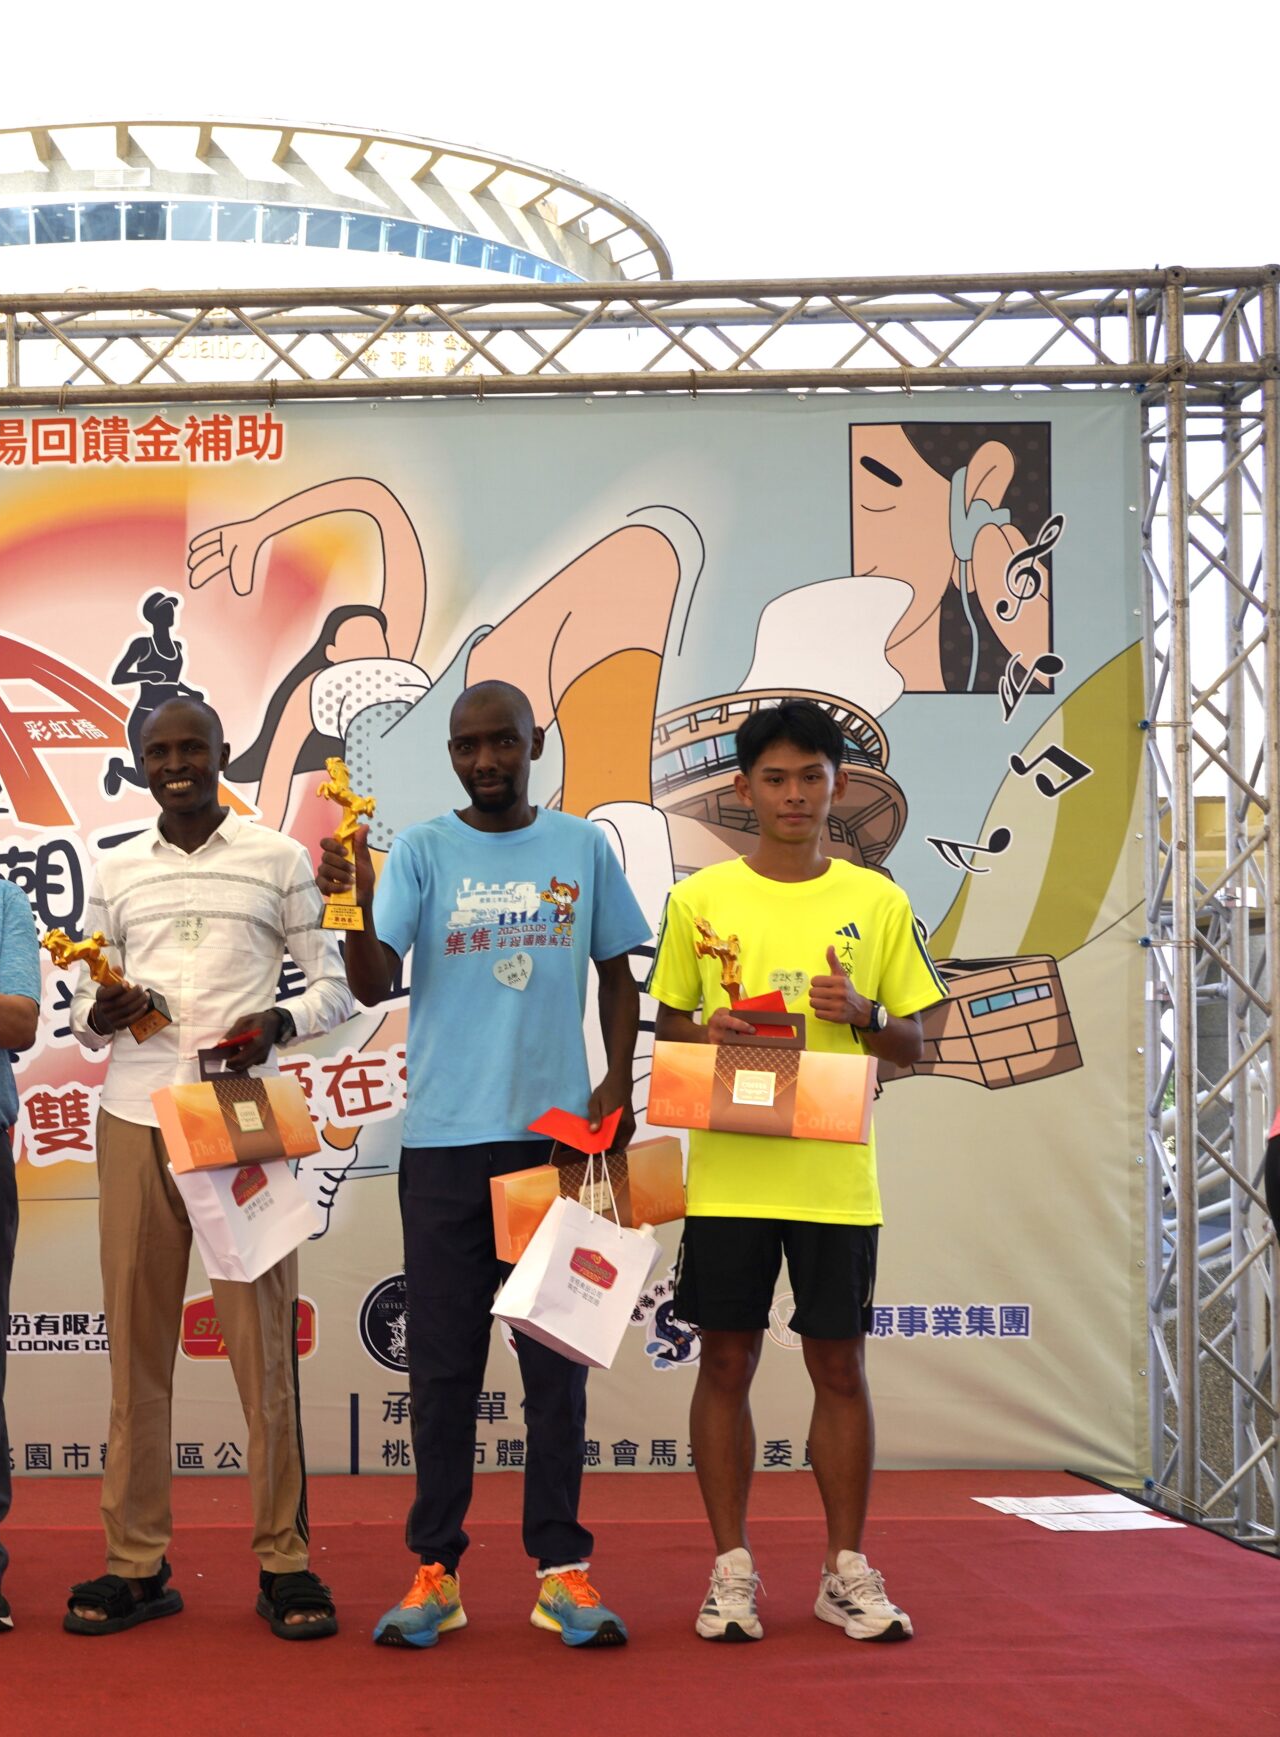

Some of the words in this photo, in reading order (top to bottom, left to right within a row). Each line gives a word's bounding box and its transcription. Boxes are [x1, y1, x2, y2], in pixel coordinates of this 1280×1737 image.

[23, 718, 109, 742] 彩虹橋
[444, 927, 492, 956] 集集
[496, 934, 574, 949] 半程國際馬拉
[322, 1054, 392, 1118] 在
[25, 1089, 94, 1156] 雙
